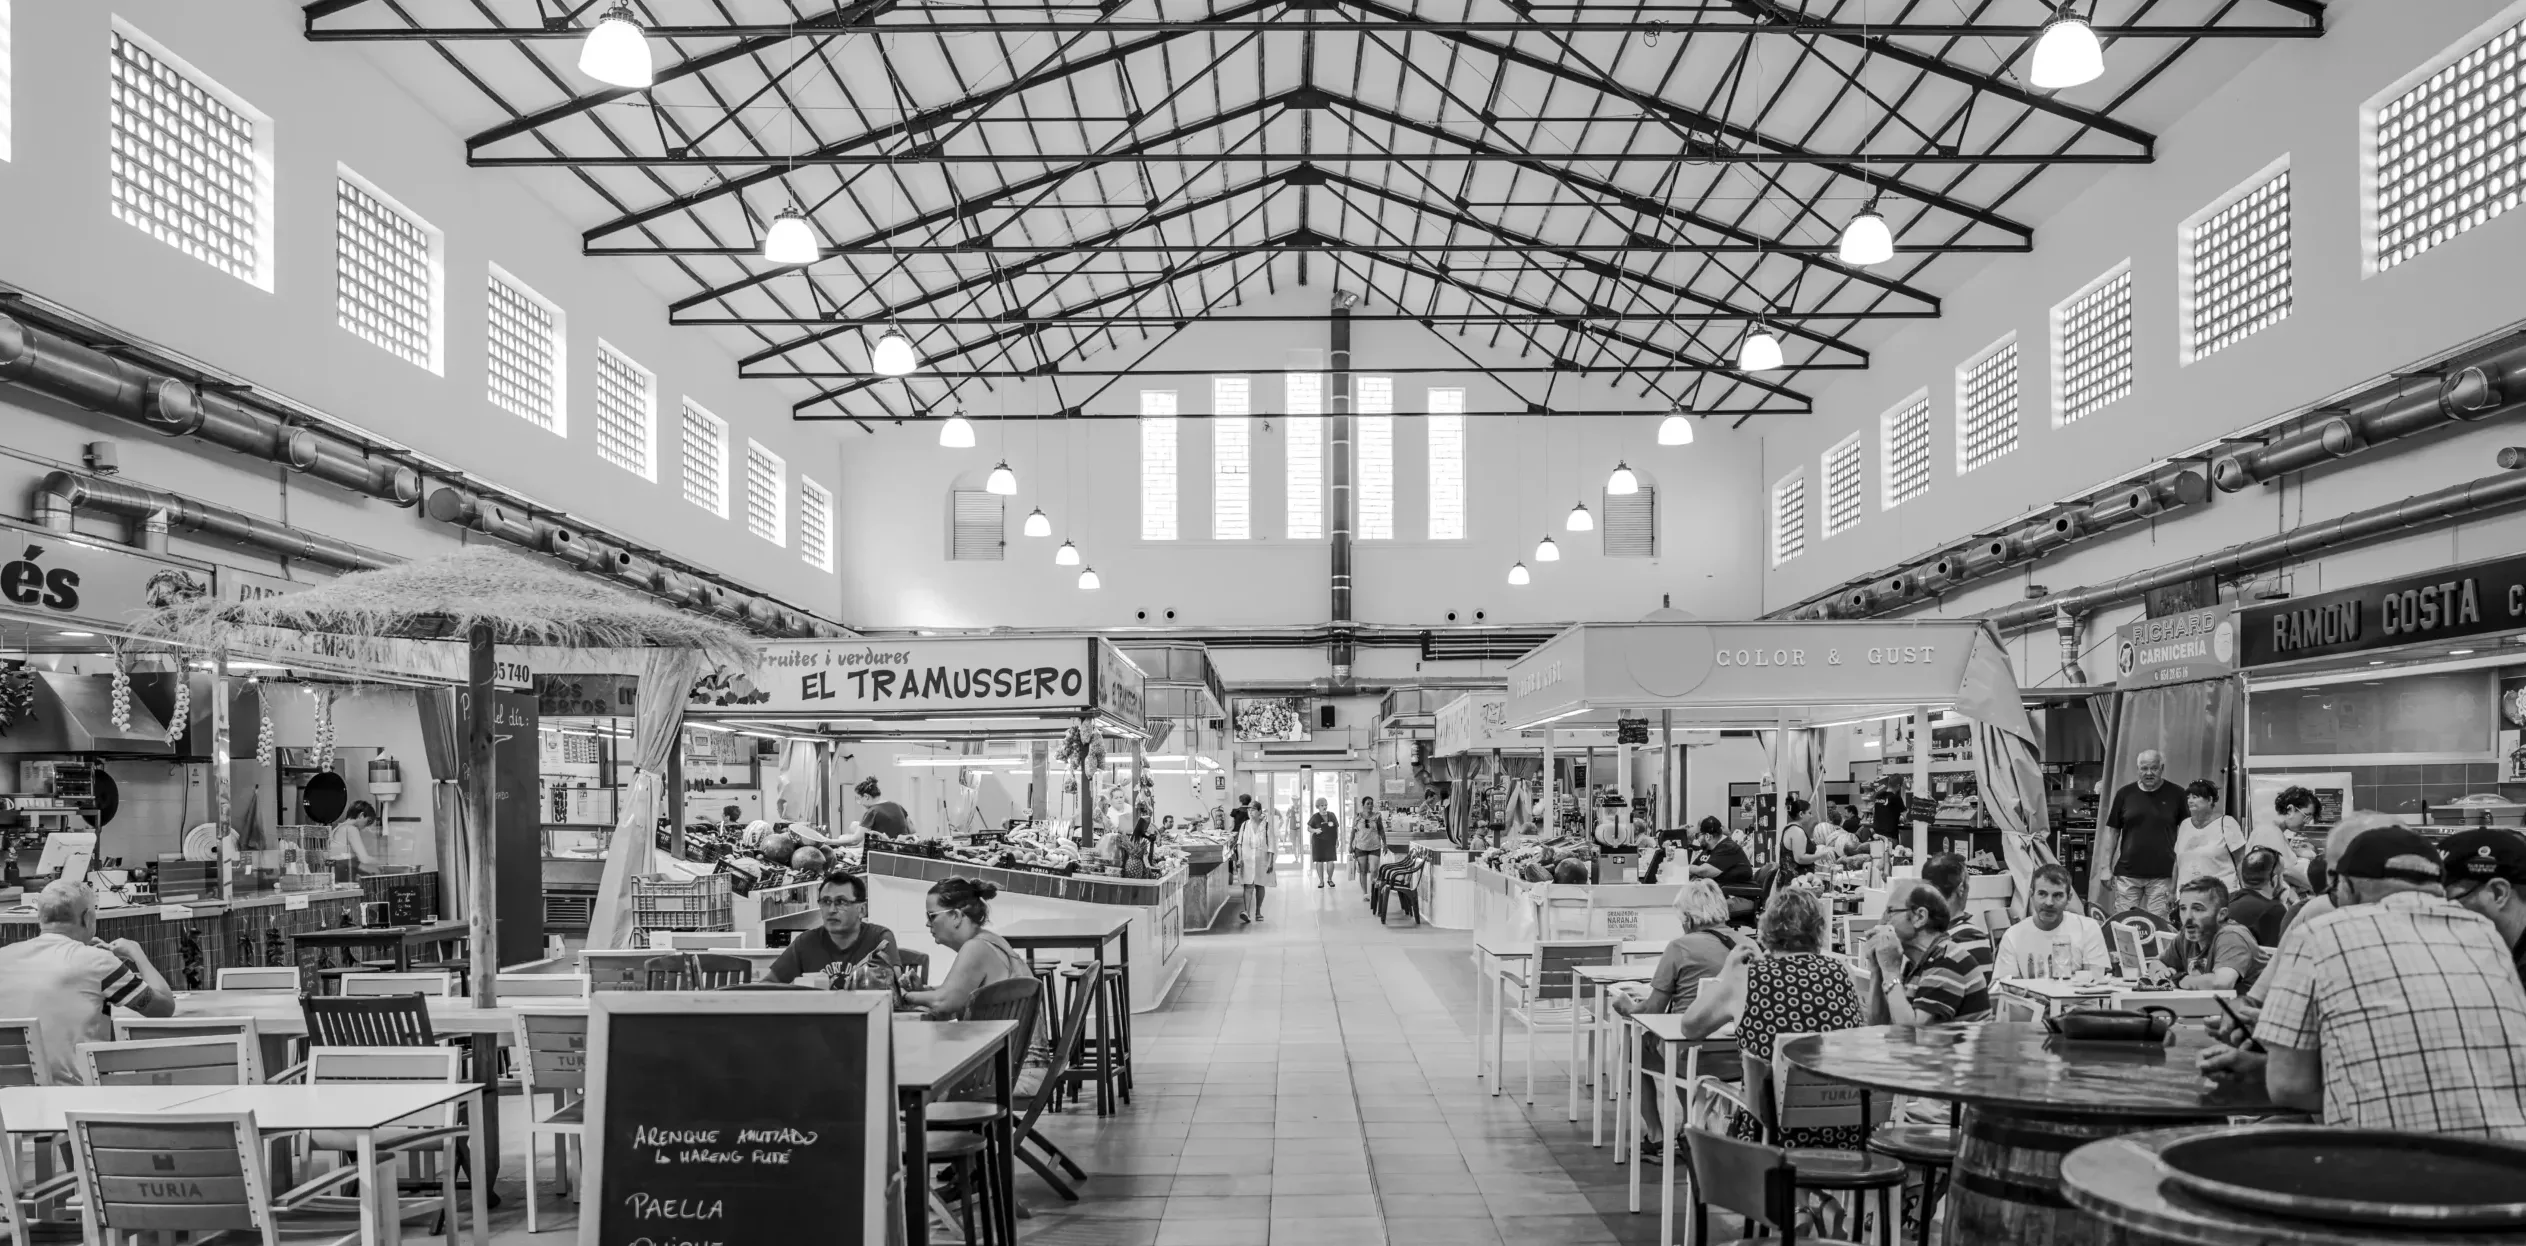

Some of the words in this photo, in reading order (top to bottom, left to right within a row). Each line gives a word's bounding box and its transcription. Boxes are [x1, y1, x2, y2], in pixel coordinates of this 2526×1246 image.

[0, 544, 80, 612] és
[2273, 599, 2361, 652] RAMON
[2383, 578, 2480, 635] COSTA
[2509, 584, 2526, 616] C
[2133, 611, 2215, 646] RICHARD
[757, 647, 818, 670] Fruites
[825, 649, 832, 666] i
[838, 647, 911, 666] verdures
[1716, 649, 1807, 667] COLOR
[1827, 648, 1842, 666] &
[1868, 646, 1935, 665] GUST
[2140, 636, 2207, 665] CARNICERÍA
[507, 663, 530, 682] 740
[802, 671, 836, 700] EL
[847, 666, 1082, 702] TRAMUSSERO
[1607, 916, 1638, 924] NARANJA
[557, 1055, 586, 1067] TUR
[633, 1124, 720, 1149] ARENQUE
[680, 1149, 744, 1164] HARENG
[137, 1182, 203, 1198] TURIA
[625, 1192, 723, 1220] PAELLA
